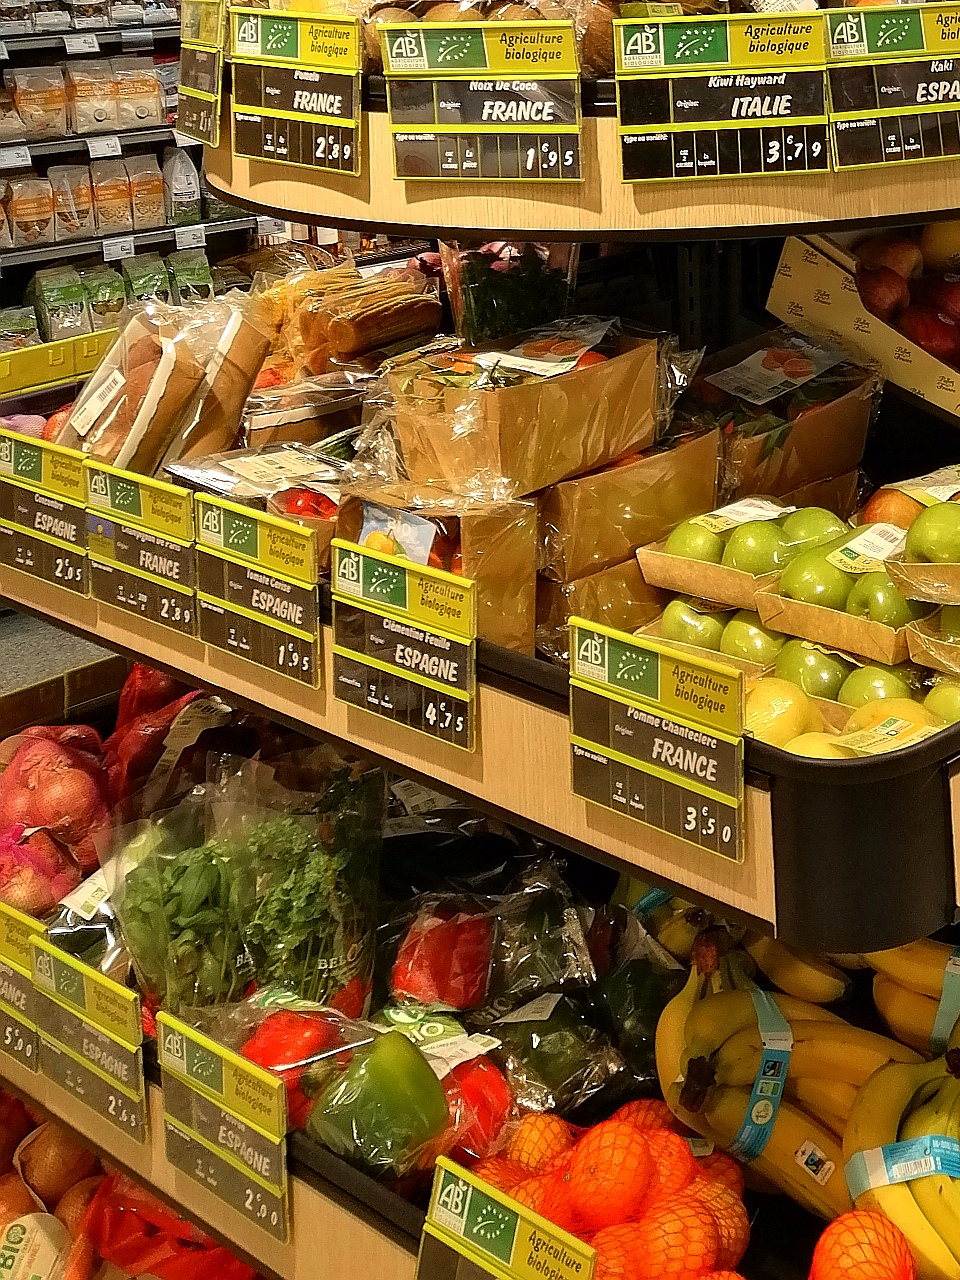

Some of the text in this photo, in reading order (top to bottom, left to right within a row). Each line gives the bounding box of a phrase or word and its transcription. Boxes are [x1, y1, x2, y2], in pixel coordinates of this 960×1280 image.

[308, 25, 350, 40] Agriculture
[500, 32, 563, 47] Agriculture
[744, 23, 812, 39] Agriculture
[310, 41, 348, 57] biologique
[505, 48, 562, 62] biologique
[749, 40, 809, 54] biologique
[930, 60, 953, 72] Kaki
[708, 73, 786, 88] Kiwi Hayward
[293, 90, 342, 115] FRANCE
[481, 101, 554, 121] FRANCE
[731, 95, 793, 118] ITALIE
[148, 489, 183, 510] Agriculture
[34, 511, 77, 542] ESPAGNE
[151, 504, 182, 525] biologique
[266, 529, 306, 552] Agriculture
[140, 549, 180, 579] FRANCE
[269, 546, 304, 567] biologique
[418, 576, 465, 603] Agriculture
[252, 588, 303, 625] ESPAGNE
[420, 594, 462, 619] biologique
[395, 644, 459, 682] ESPAGNE
[671, 664, 729, 696] Agriculture
[674, 684, 726, 714] biologique
[626, 706, 661, 729] Pomme
[651, 736, 718, 782] FRANCE
[82, 1037, 130, 1082] ESPAGNE
[232, 1067, 275, 1101] Agriculture
[235, 1085, 272, 1116] biologique
[218, 1125, 271, 1177] ESPAGNE
[438, 1183, 463, 1215] AB
[0, 1223, 27, 1270] BIO
[528, 1230, 583, 1273] Agriculture
